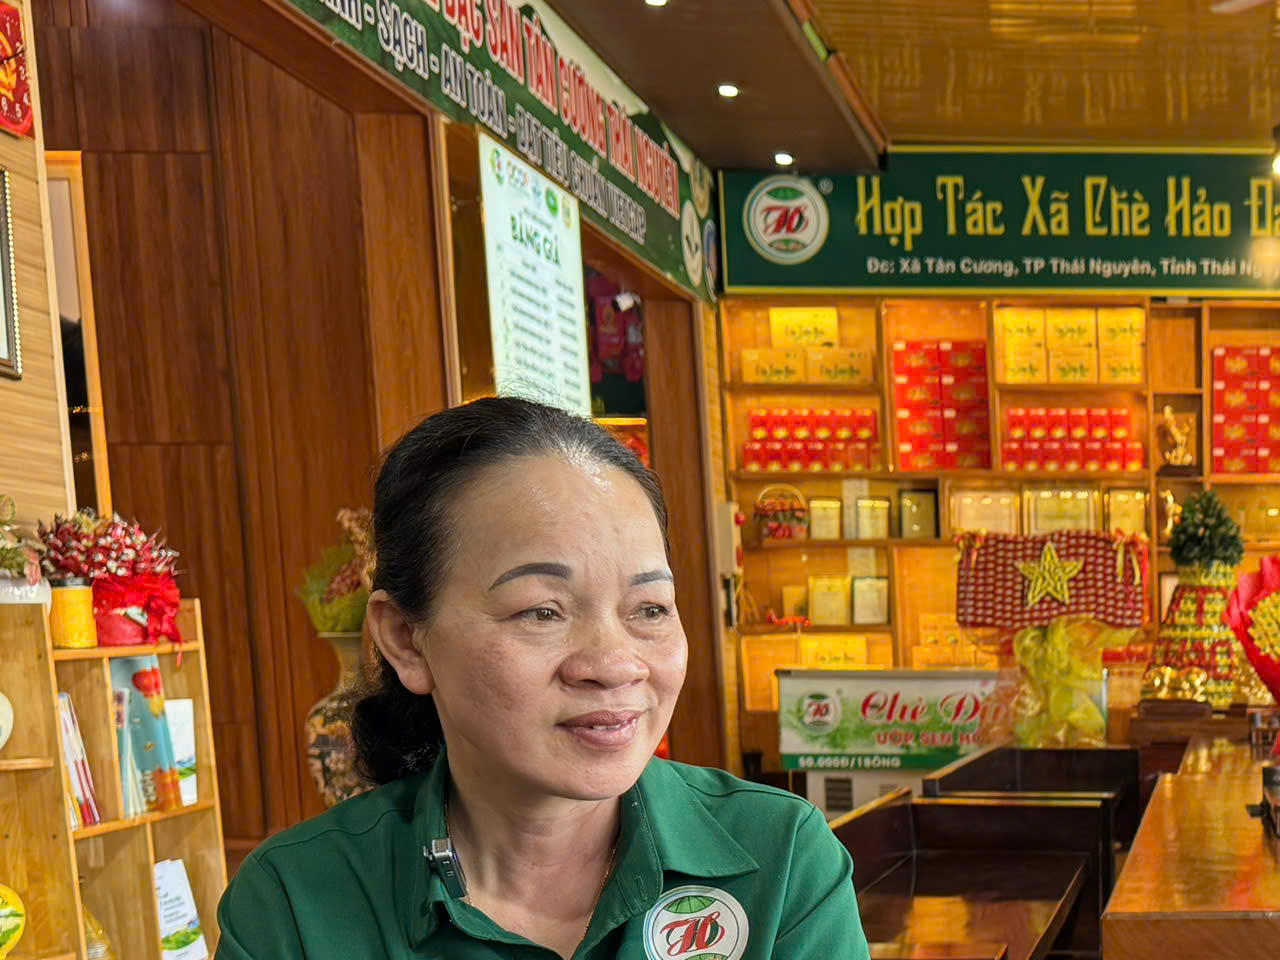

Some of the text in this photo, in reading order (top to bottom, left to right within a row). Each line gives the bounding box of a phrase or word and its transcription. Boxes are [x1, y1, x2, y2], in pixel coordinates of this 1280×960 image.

[376, 0, 429, 80] SẠCH
[441, 42, 467, 108] AN
[466, 61, 508, 139] TOÀN
[855, 175, 923, 251] Hợp
[935, 175, 1005, 236] Tác
[1021, 175, 1070, 236] Xã
[1084, 176, 1151, 237] Chè
[1164, 176, 1232, 237] Hảo
[1023, 257, 1046, 275] TP
[1050, 256, 1086, 275] Thái
[1200, 257, 1236, 276] Thái
